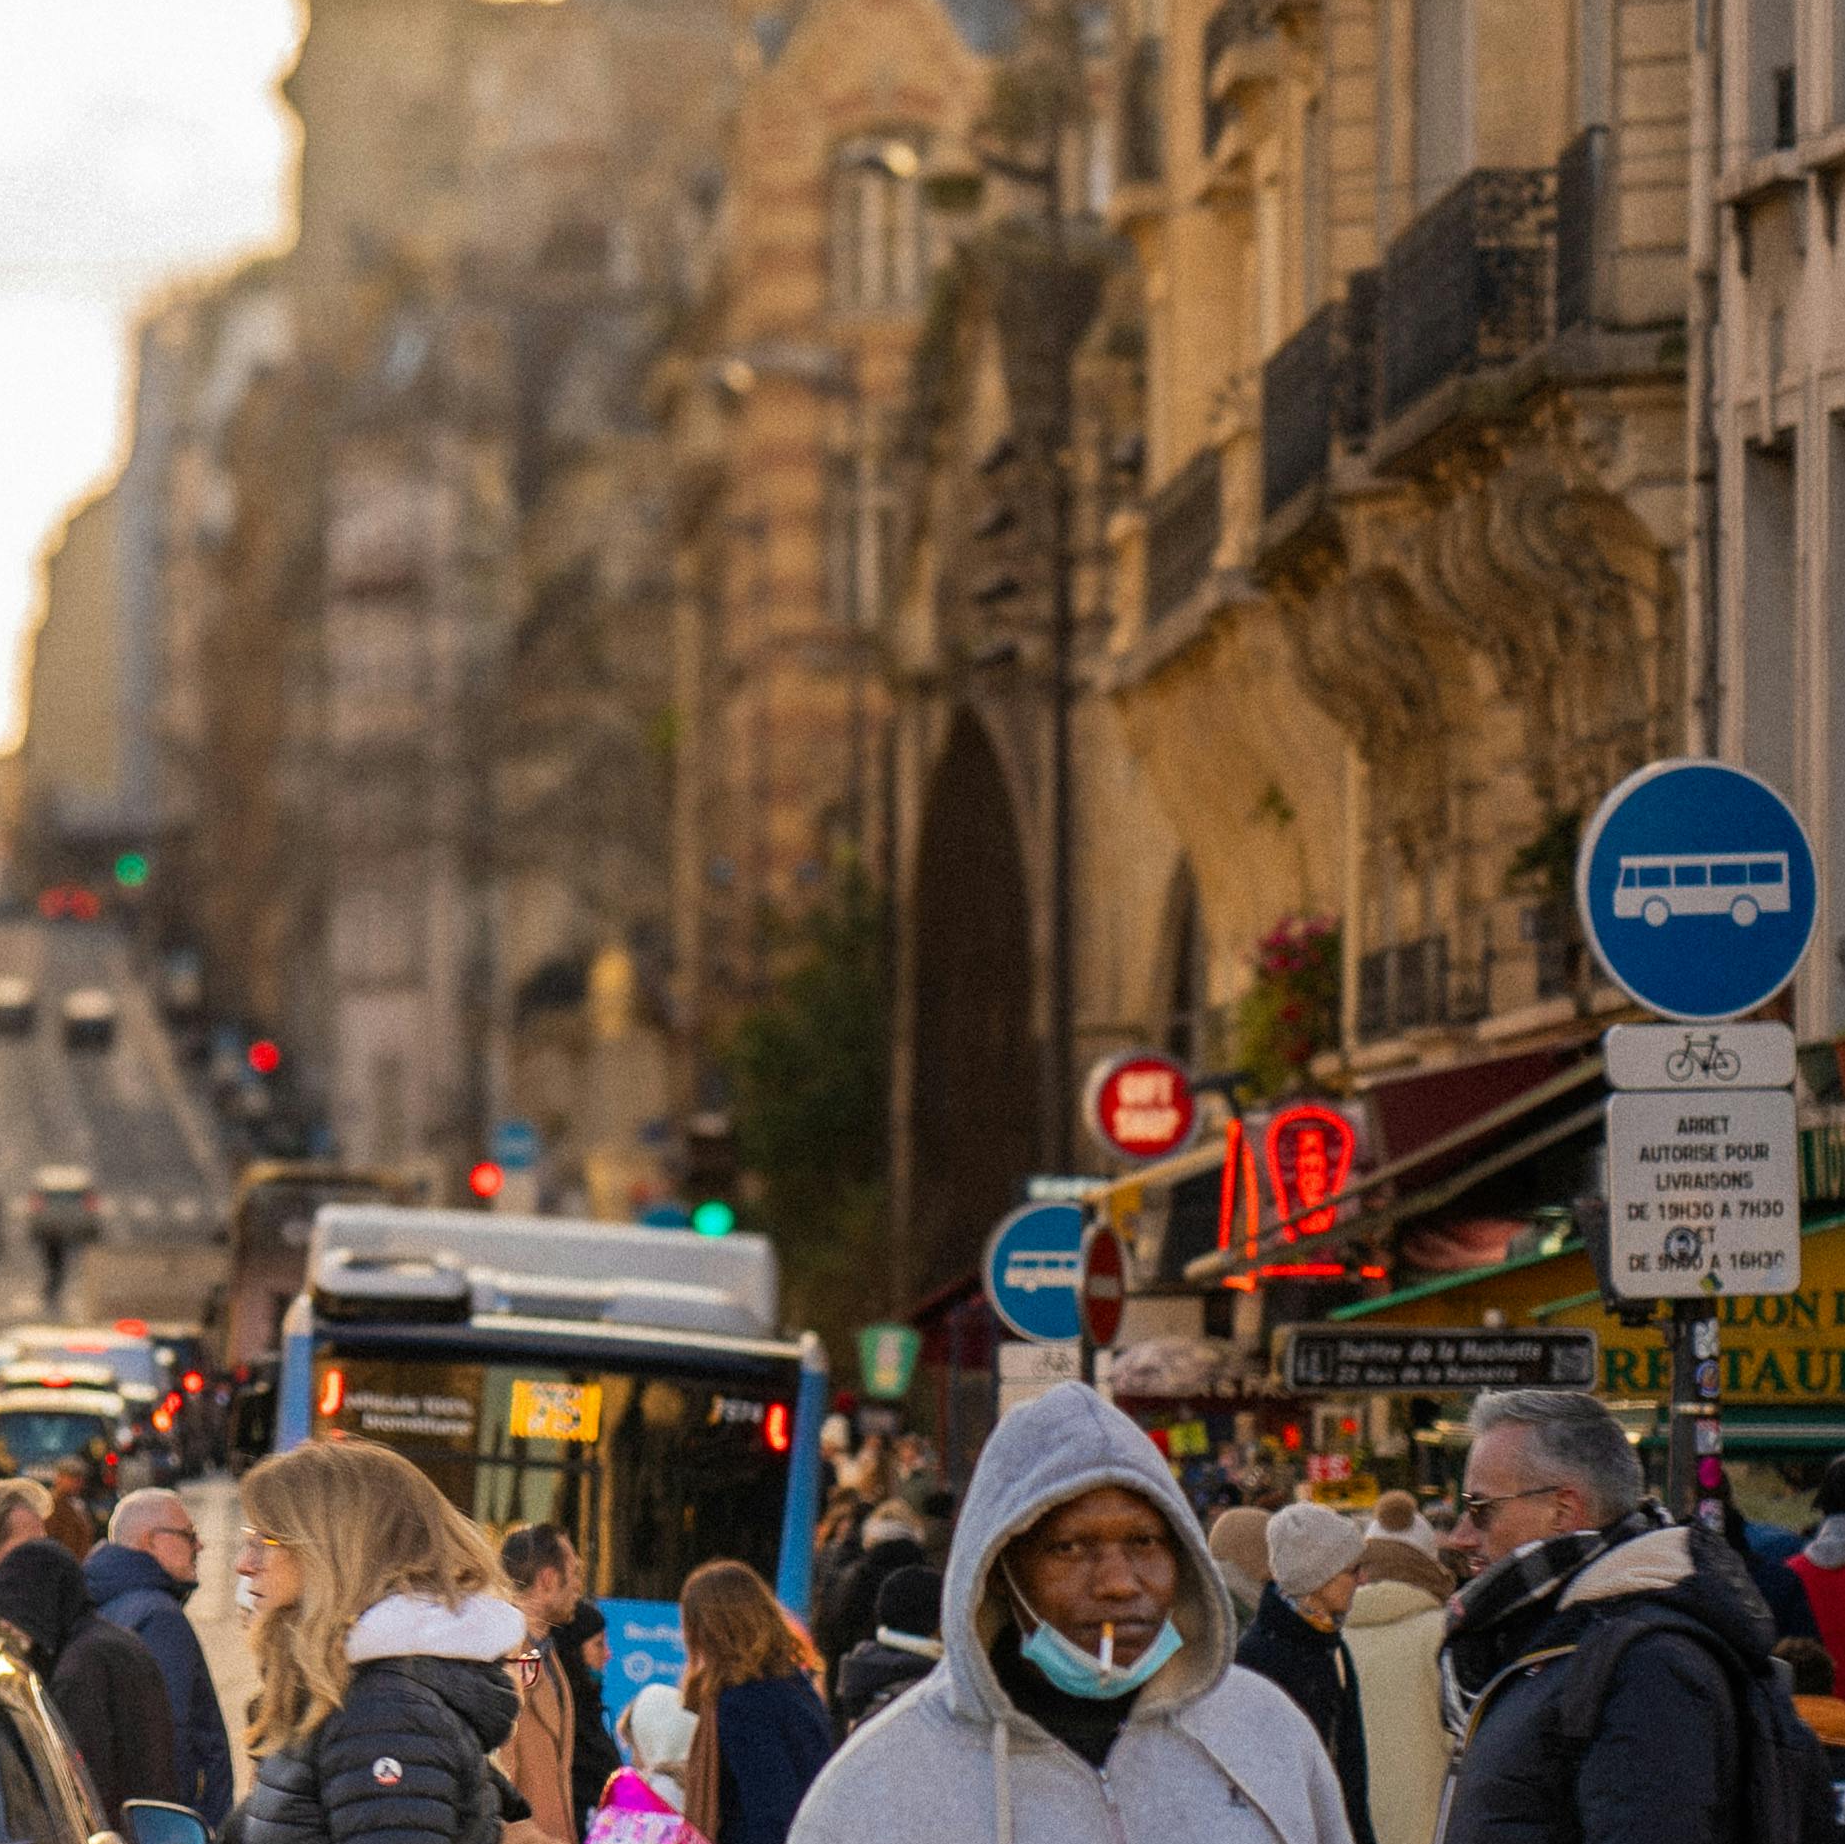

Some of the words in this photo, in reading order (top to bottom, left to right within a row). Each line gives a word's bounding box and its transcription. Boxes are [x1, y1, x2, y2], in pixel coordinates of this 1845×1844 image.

[1677, 1116, 1730, 1135] ARRET
[1640, 1144, 1718, 1163] AUTORISE
[1725, 1143, 1769, 1161] POUR
[1656, 1171, 1754, 1191] LIVRAISONS
[1627, 1203, 1650, 1221] DE
[1659, 1202, 1714, 1220] 19H30
[1721, 1203, 1732, 1218] A
[1739, 1200, 1784, 1218] 7H30
[1628, 1254, 1650, 1272] DE
[1710, 1254, 1721, 1268] A
[1603, 1347, 1845, 1392] RETAU
